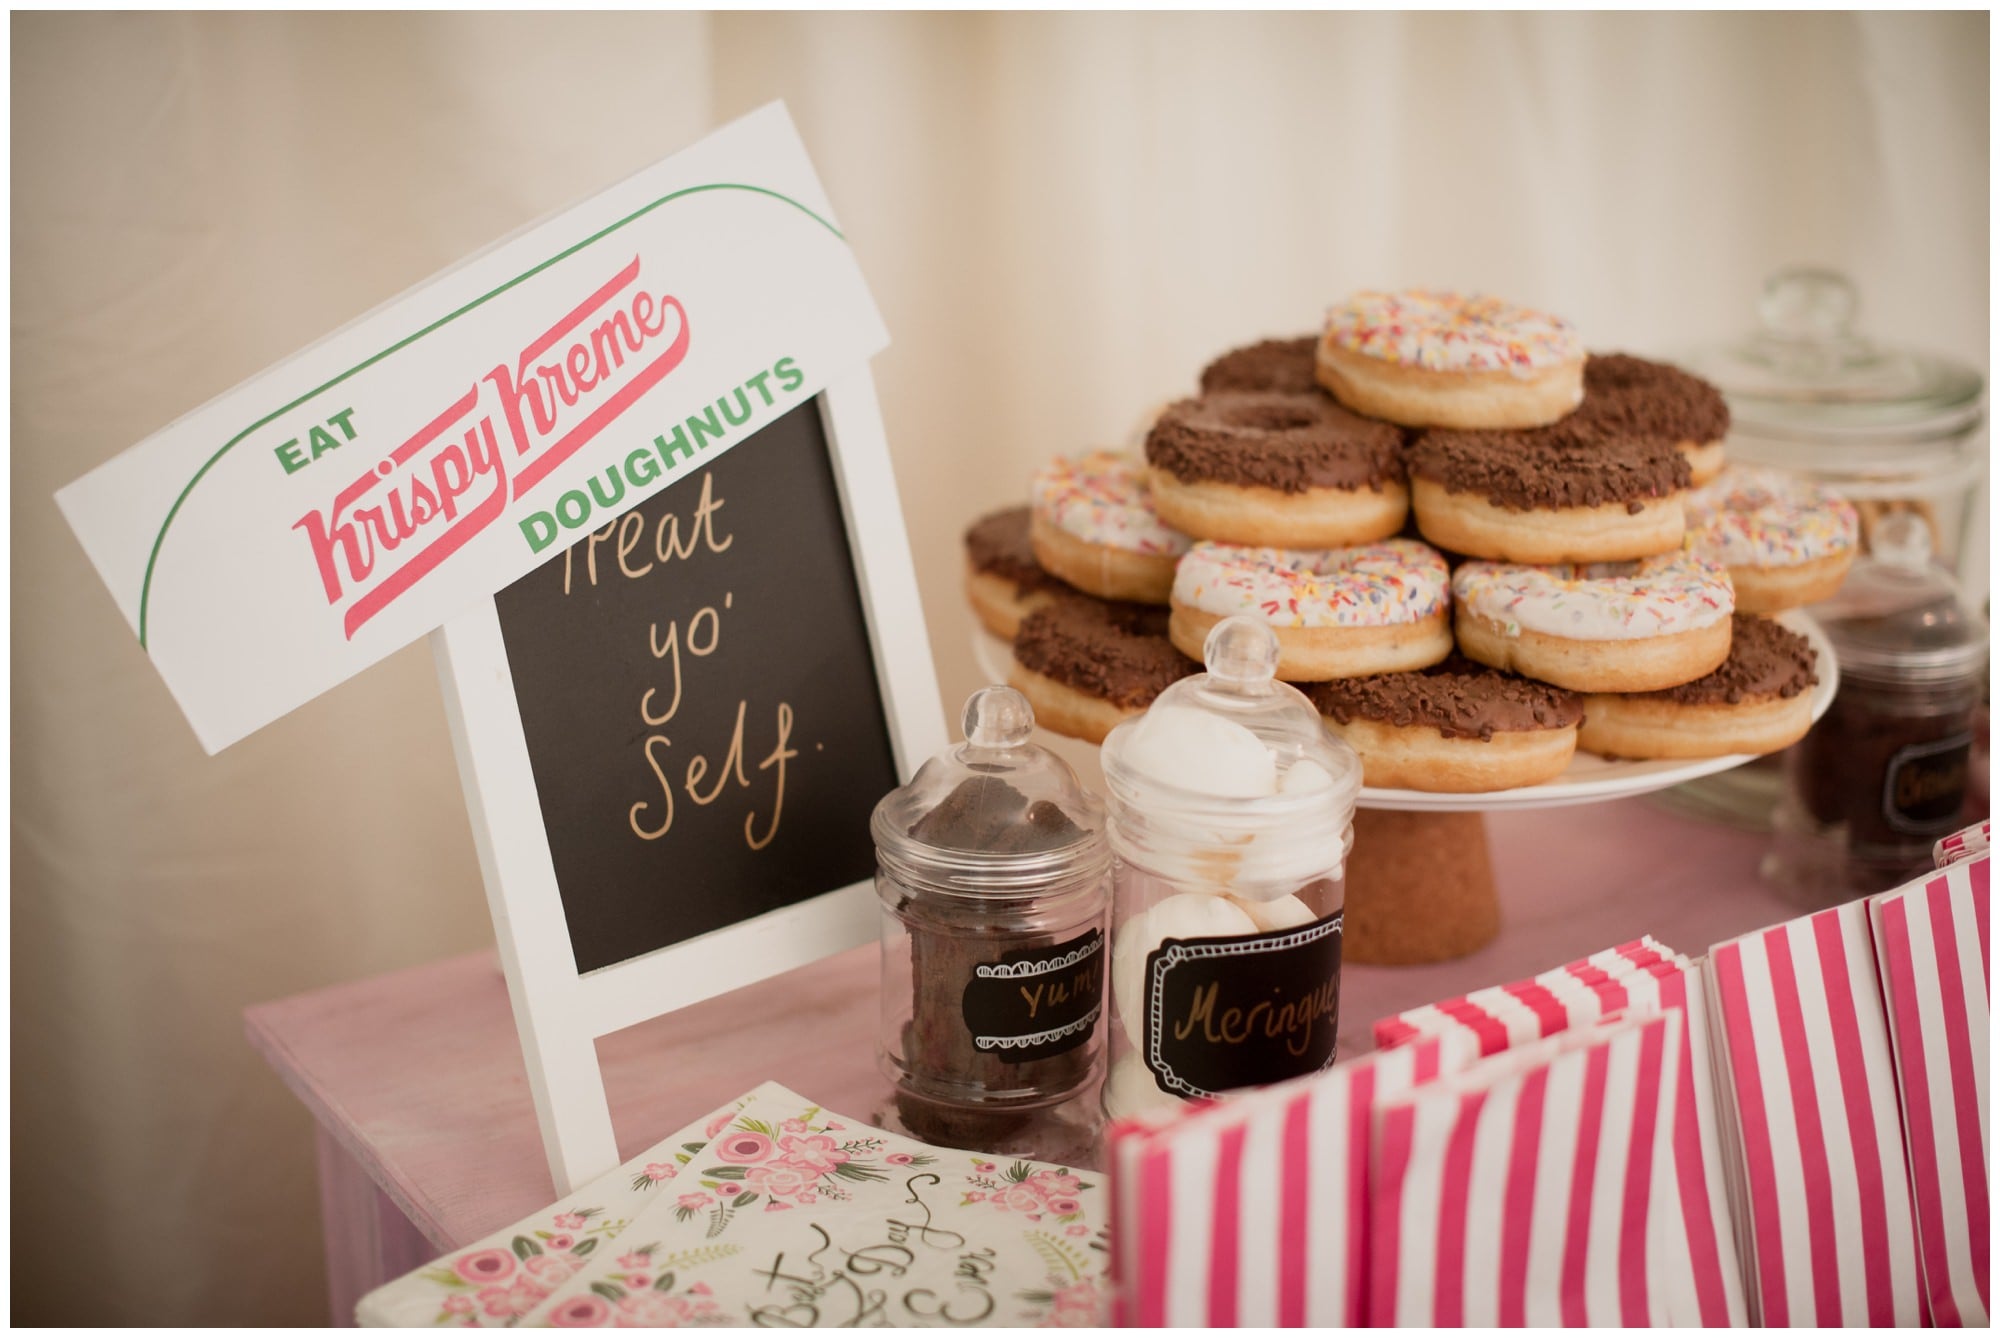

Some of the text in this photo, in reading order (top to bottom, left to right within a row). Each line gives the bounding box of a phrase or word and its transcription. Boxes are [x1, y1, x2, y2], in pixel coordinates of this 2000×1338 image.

[274, 408, 357, 475] EAT
[292, 254, 690, 640] Krispy Kreme
[519, 357, 804, 554] DOUGHNUTS
